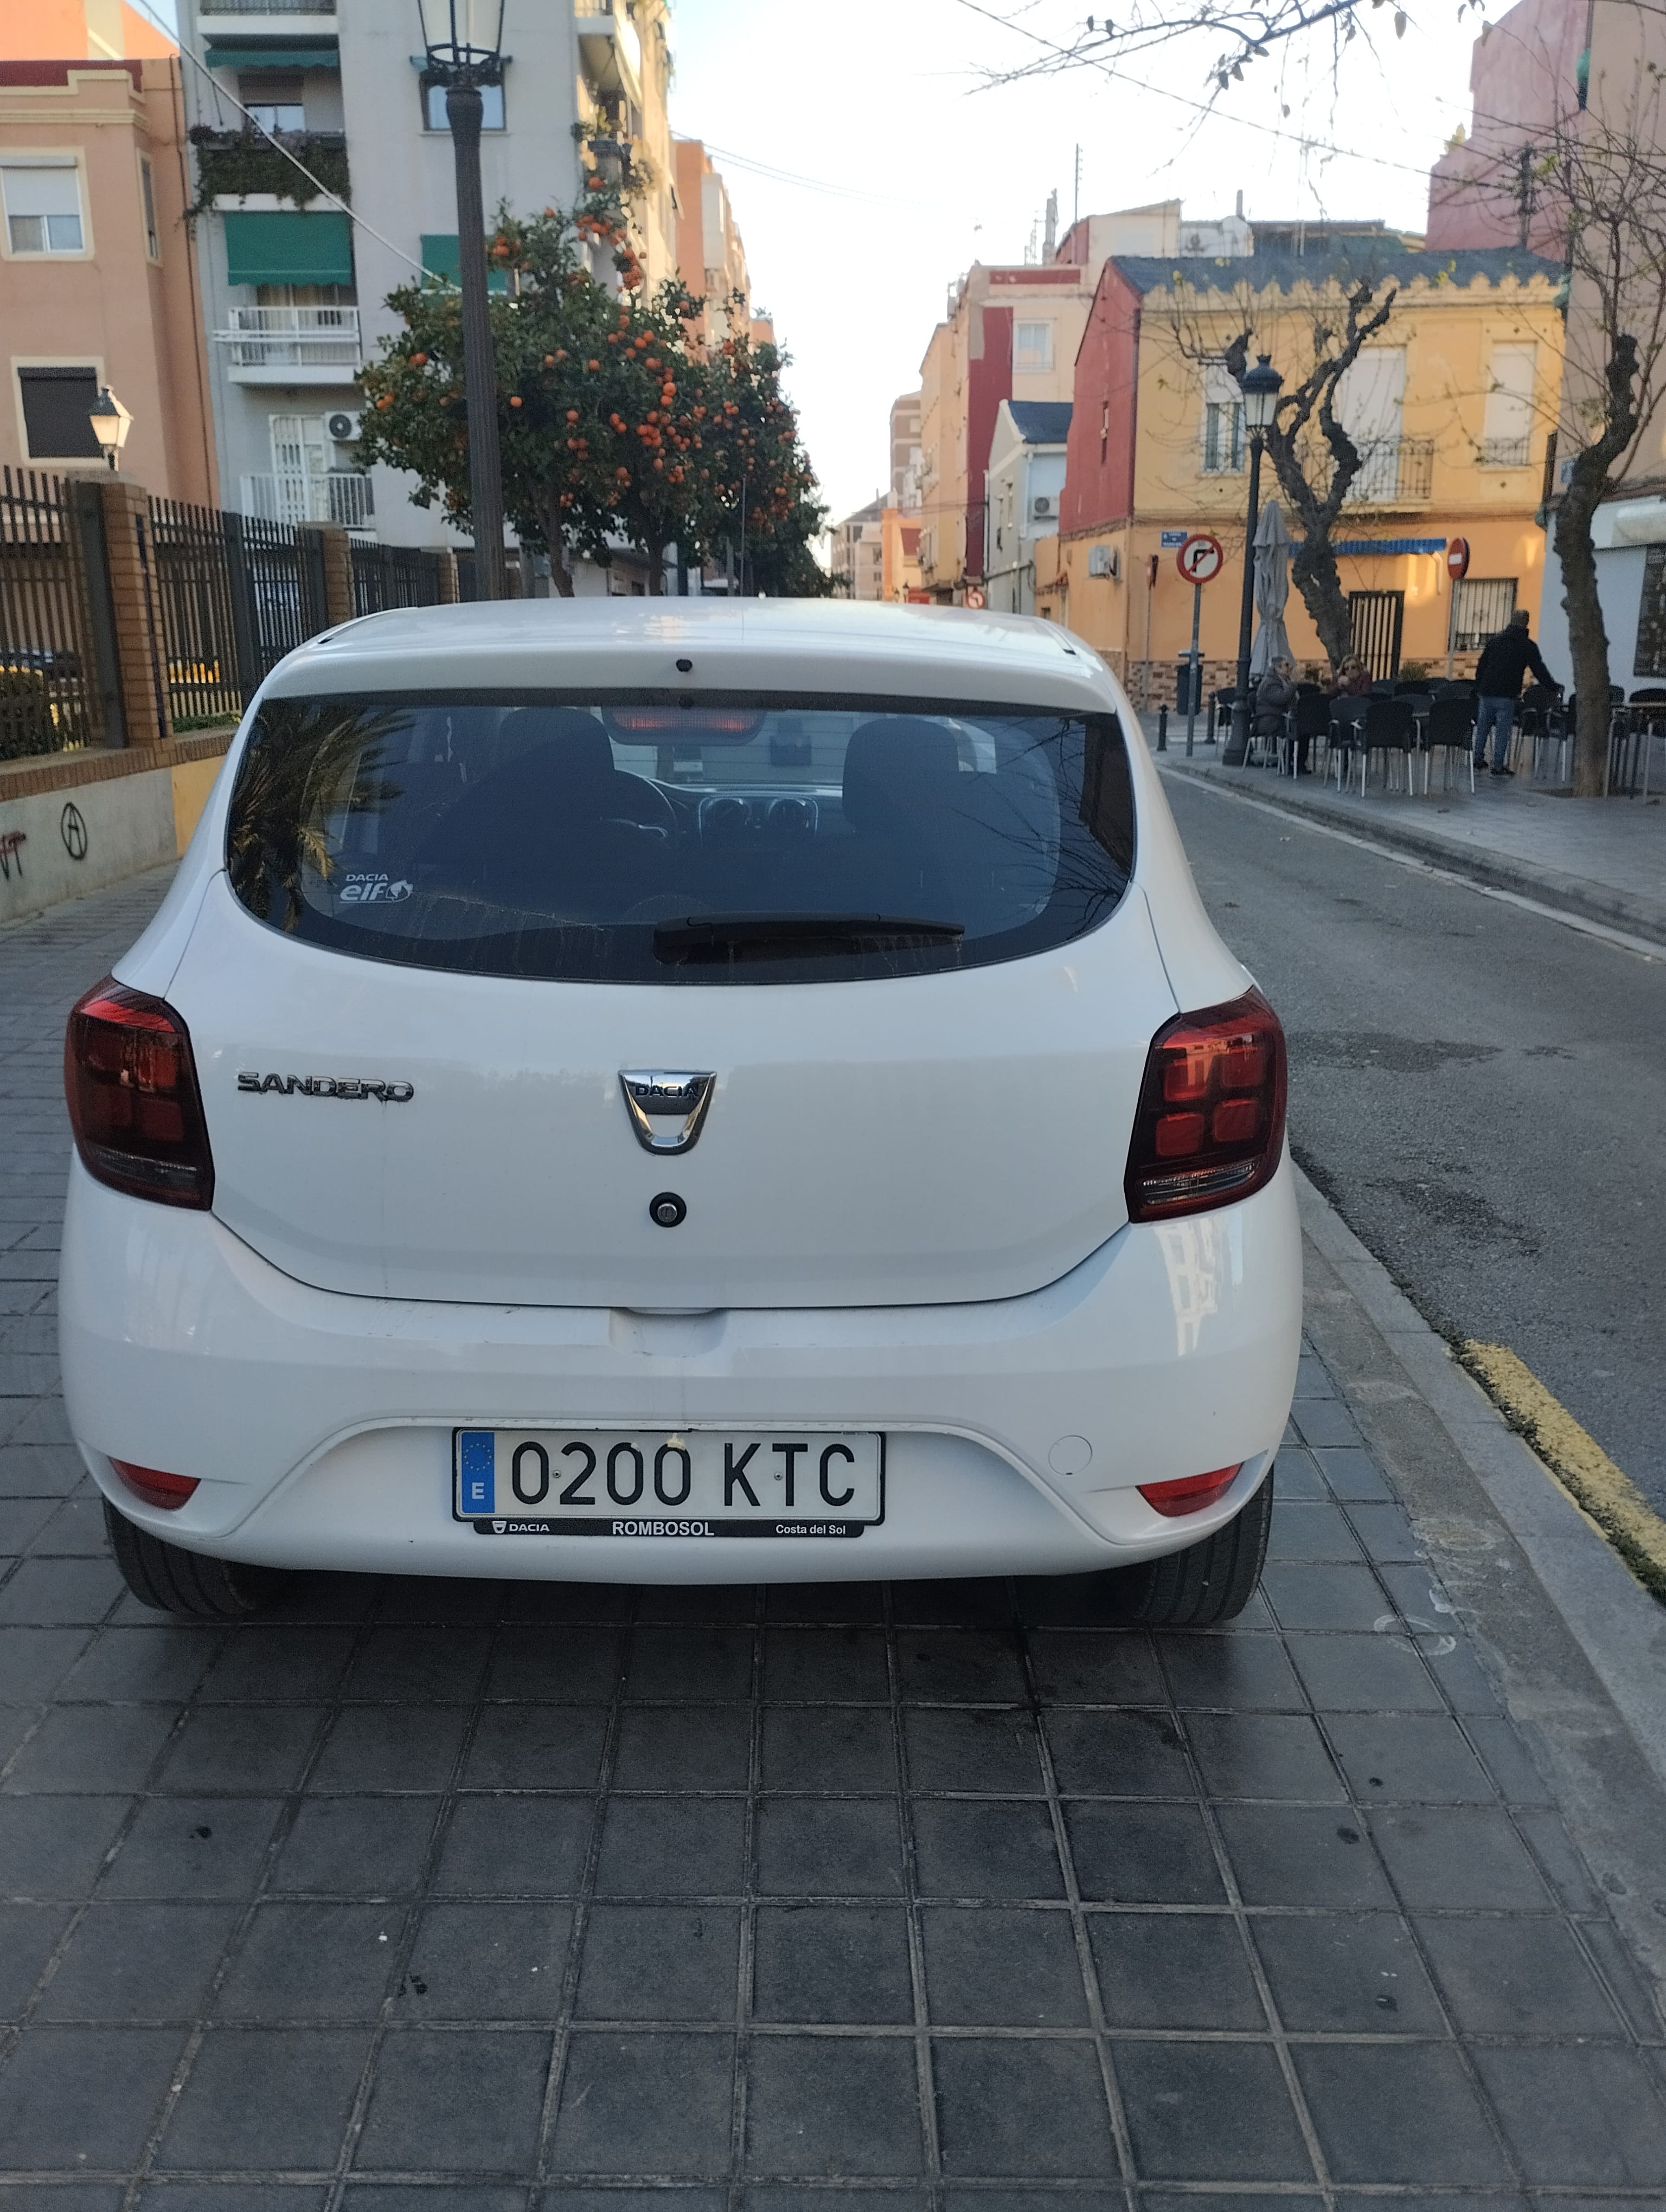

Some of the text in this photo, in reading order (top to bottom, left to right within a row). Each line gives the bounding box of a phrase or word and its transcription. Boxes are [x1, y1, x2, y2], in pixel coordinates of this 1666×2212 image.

[345, 873, 389, 882] DACIA
[339, 883, 388, 901] elf
[238, 1072, 414, 1102] SANDERO
[635, 1085, 699, 1097] DACIA
[511, 1441, 856, 1508] 0200 KTC
[471, 1482, 485, 1500] E
[509, 1523, 550, 1532] DACIA
[612, 1521, 715, 1535] ROMBOSOL
[776, 1524, 846, 1535] Costa del Sol
